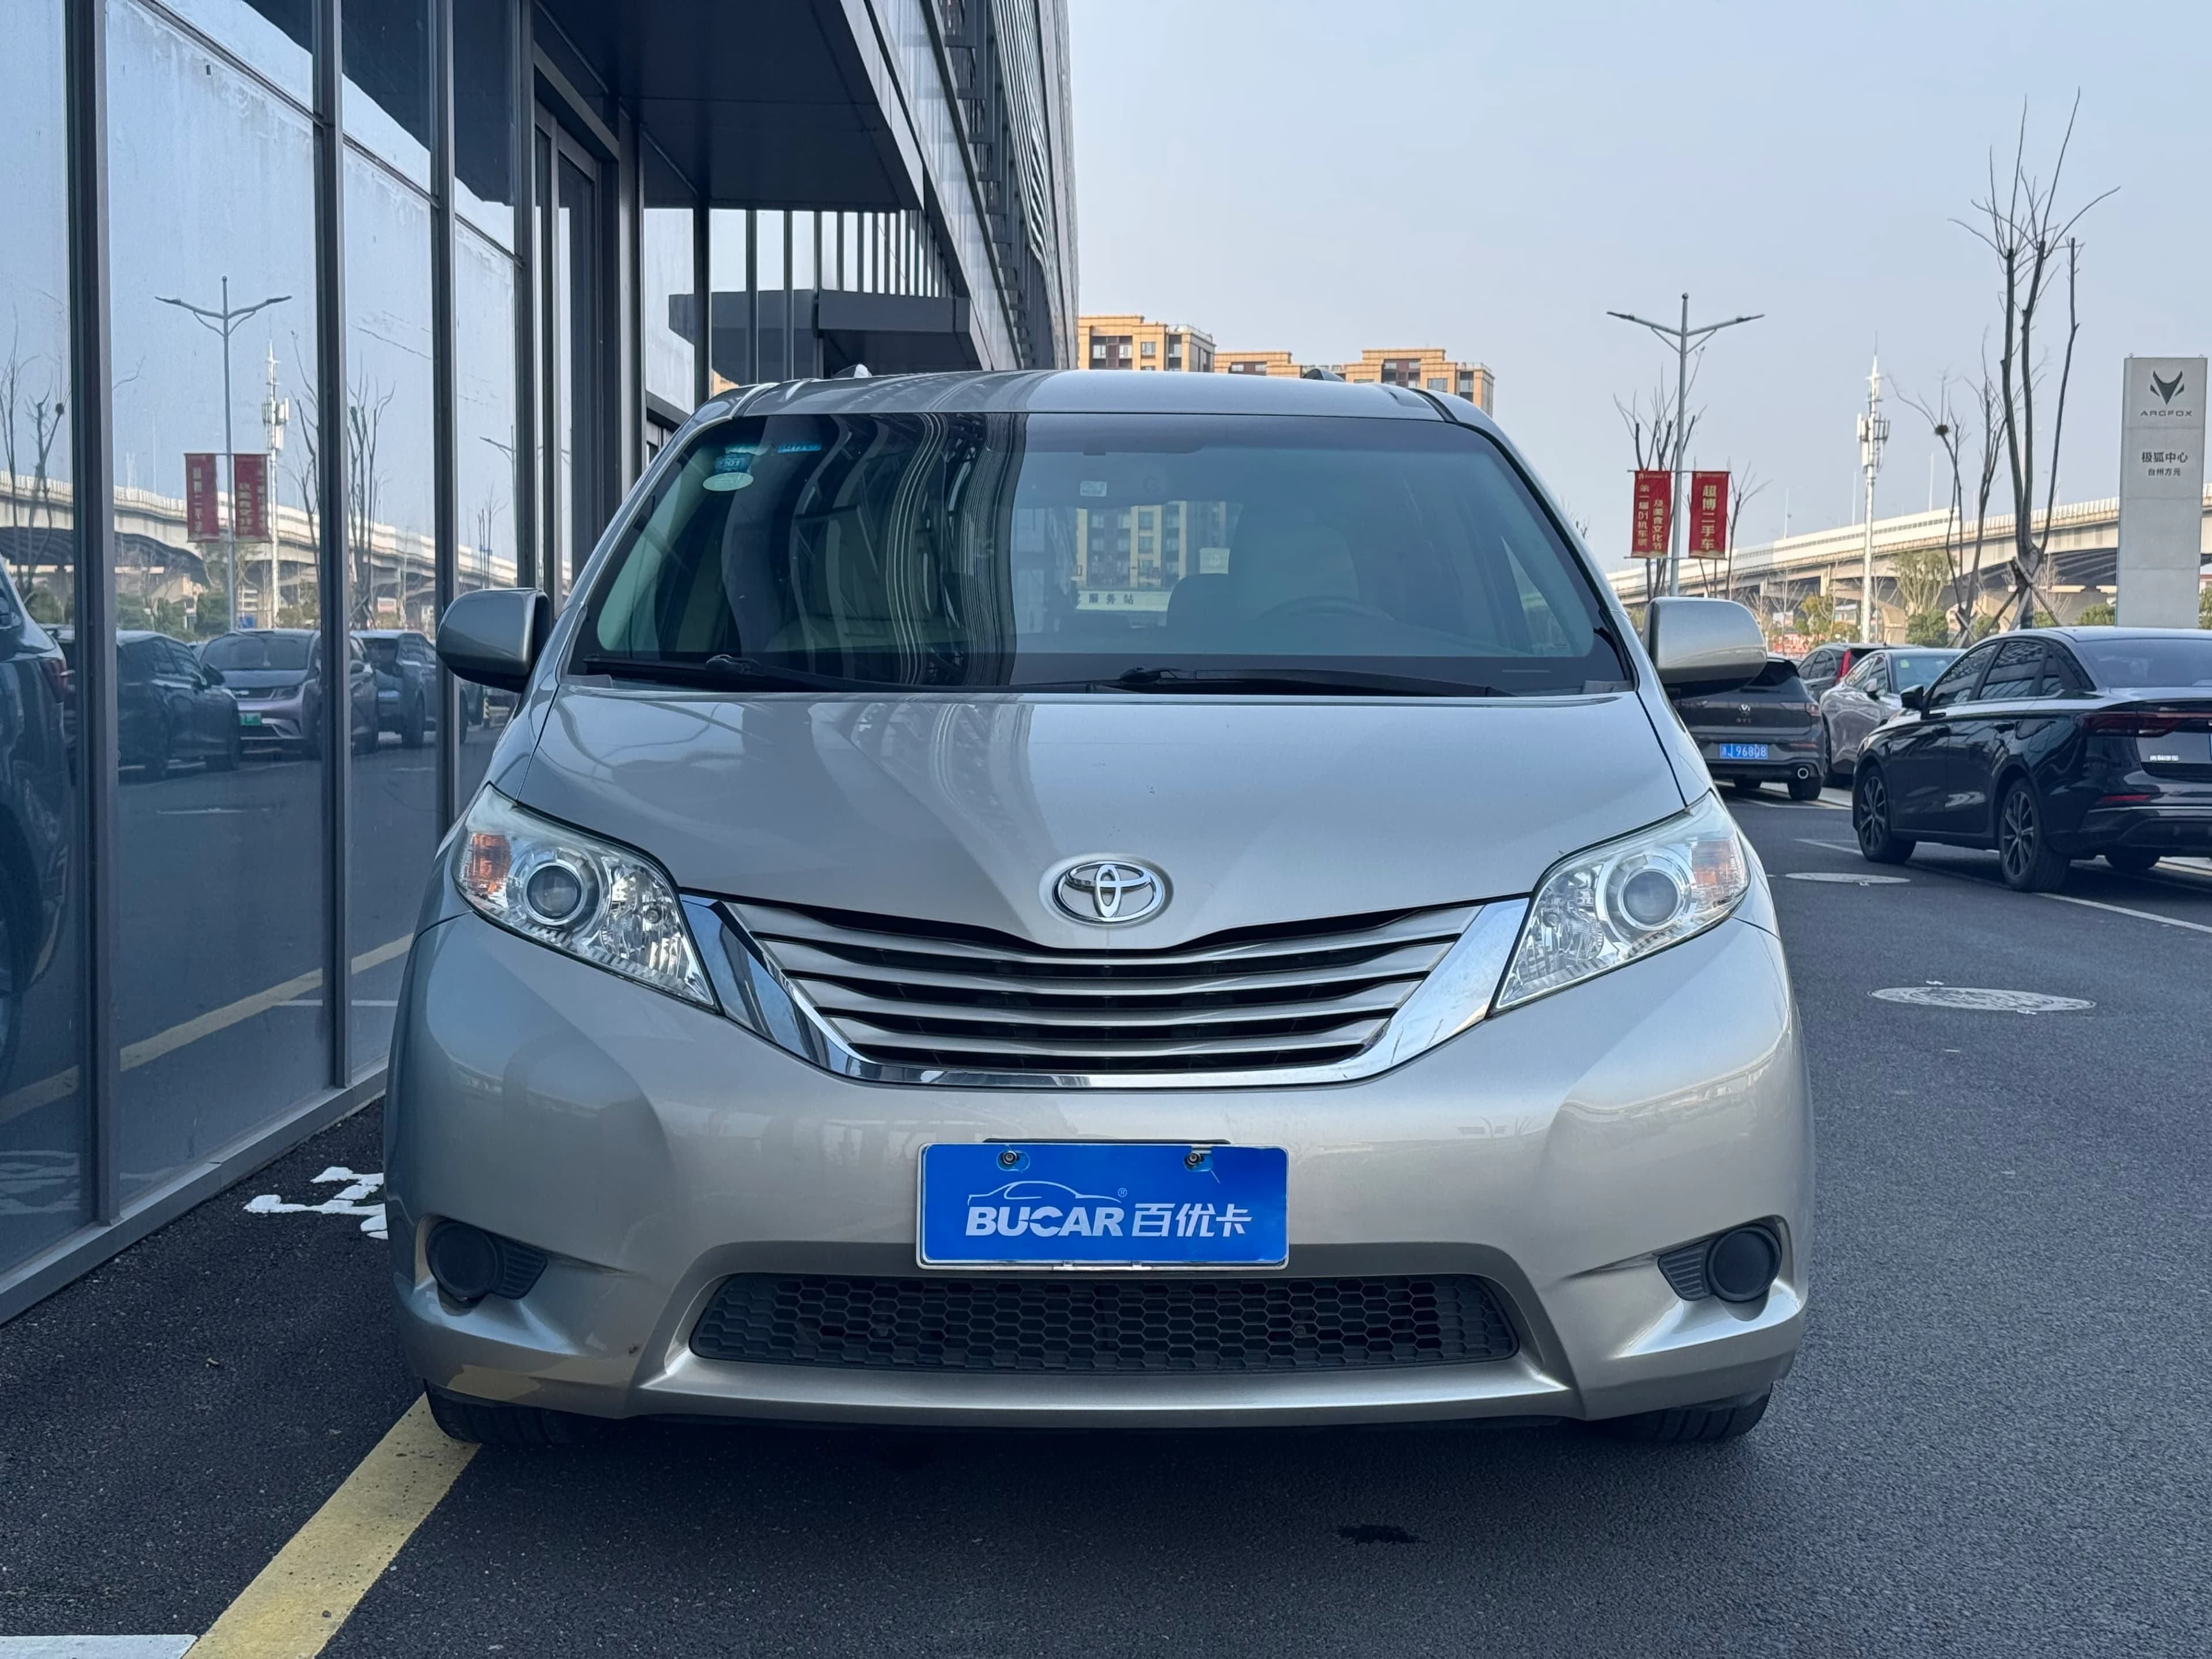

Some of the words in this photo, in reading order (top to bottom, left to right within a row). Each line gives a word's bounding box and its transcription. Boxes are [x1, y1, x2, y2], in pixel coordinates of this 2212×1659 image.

[2142, 452, 2188, 464] 极狐中心
[965, 1207, 1124, 1237] BUCAR
[1132, 1203, 1252, 1237] 百优卡
